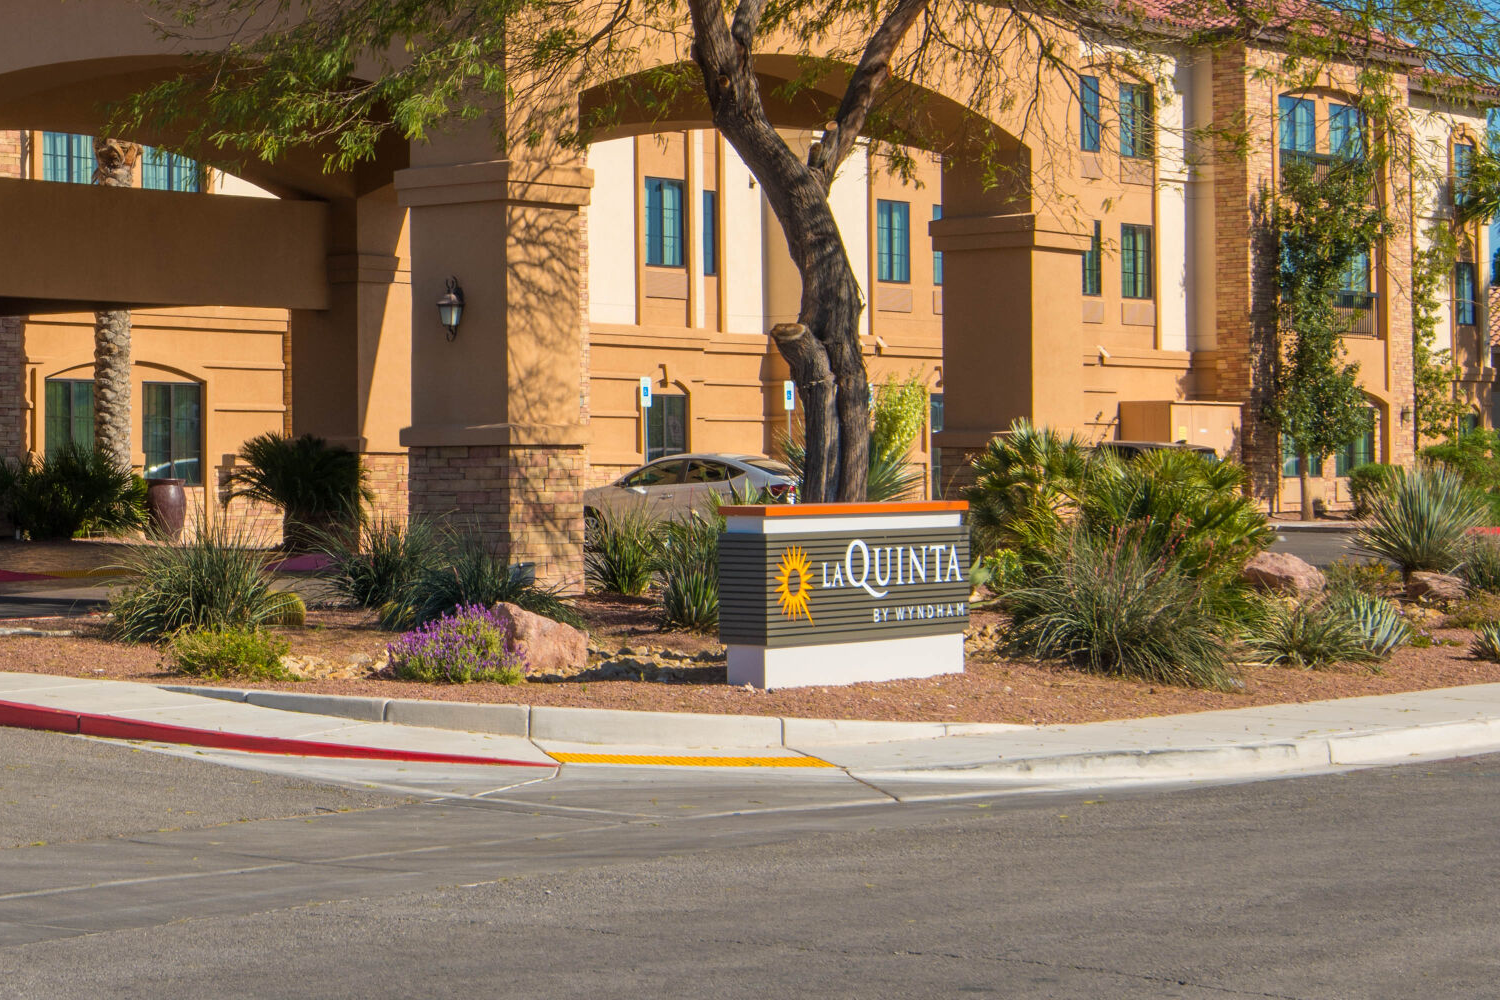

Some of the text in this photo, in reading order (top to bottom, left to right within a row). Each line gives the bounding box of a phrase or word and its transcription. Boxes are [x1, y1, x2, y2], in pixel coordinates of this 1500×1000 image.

[821, 539, 964, 598] LA QUINTA
[873, 602, 965, 623] BY WYNDHAM
